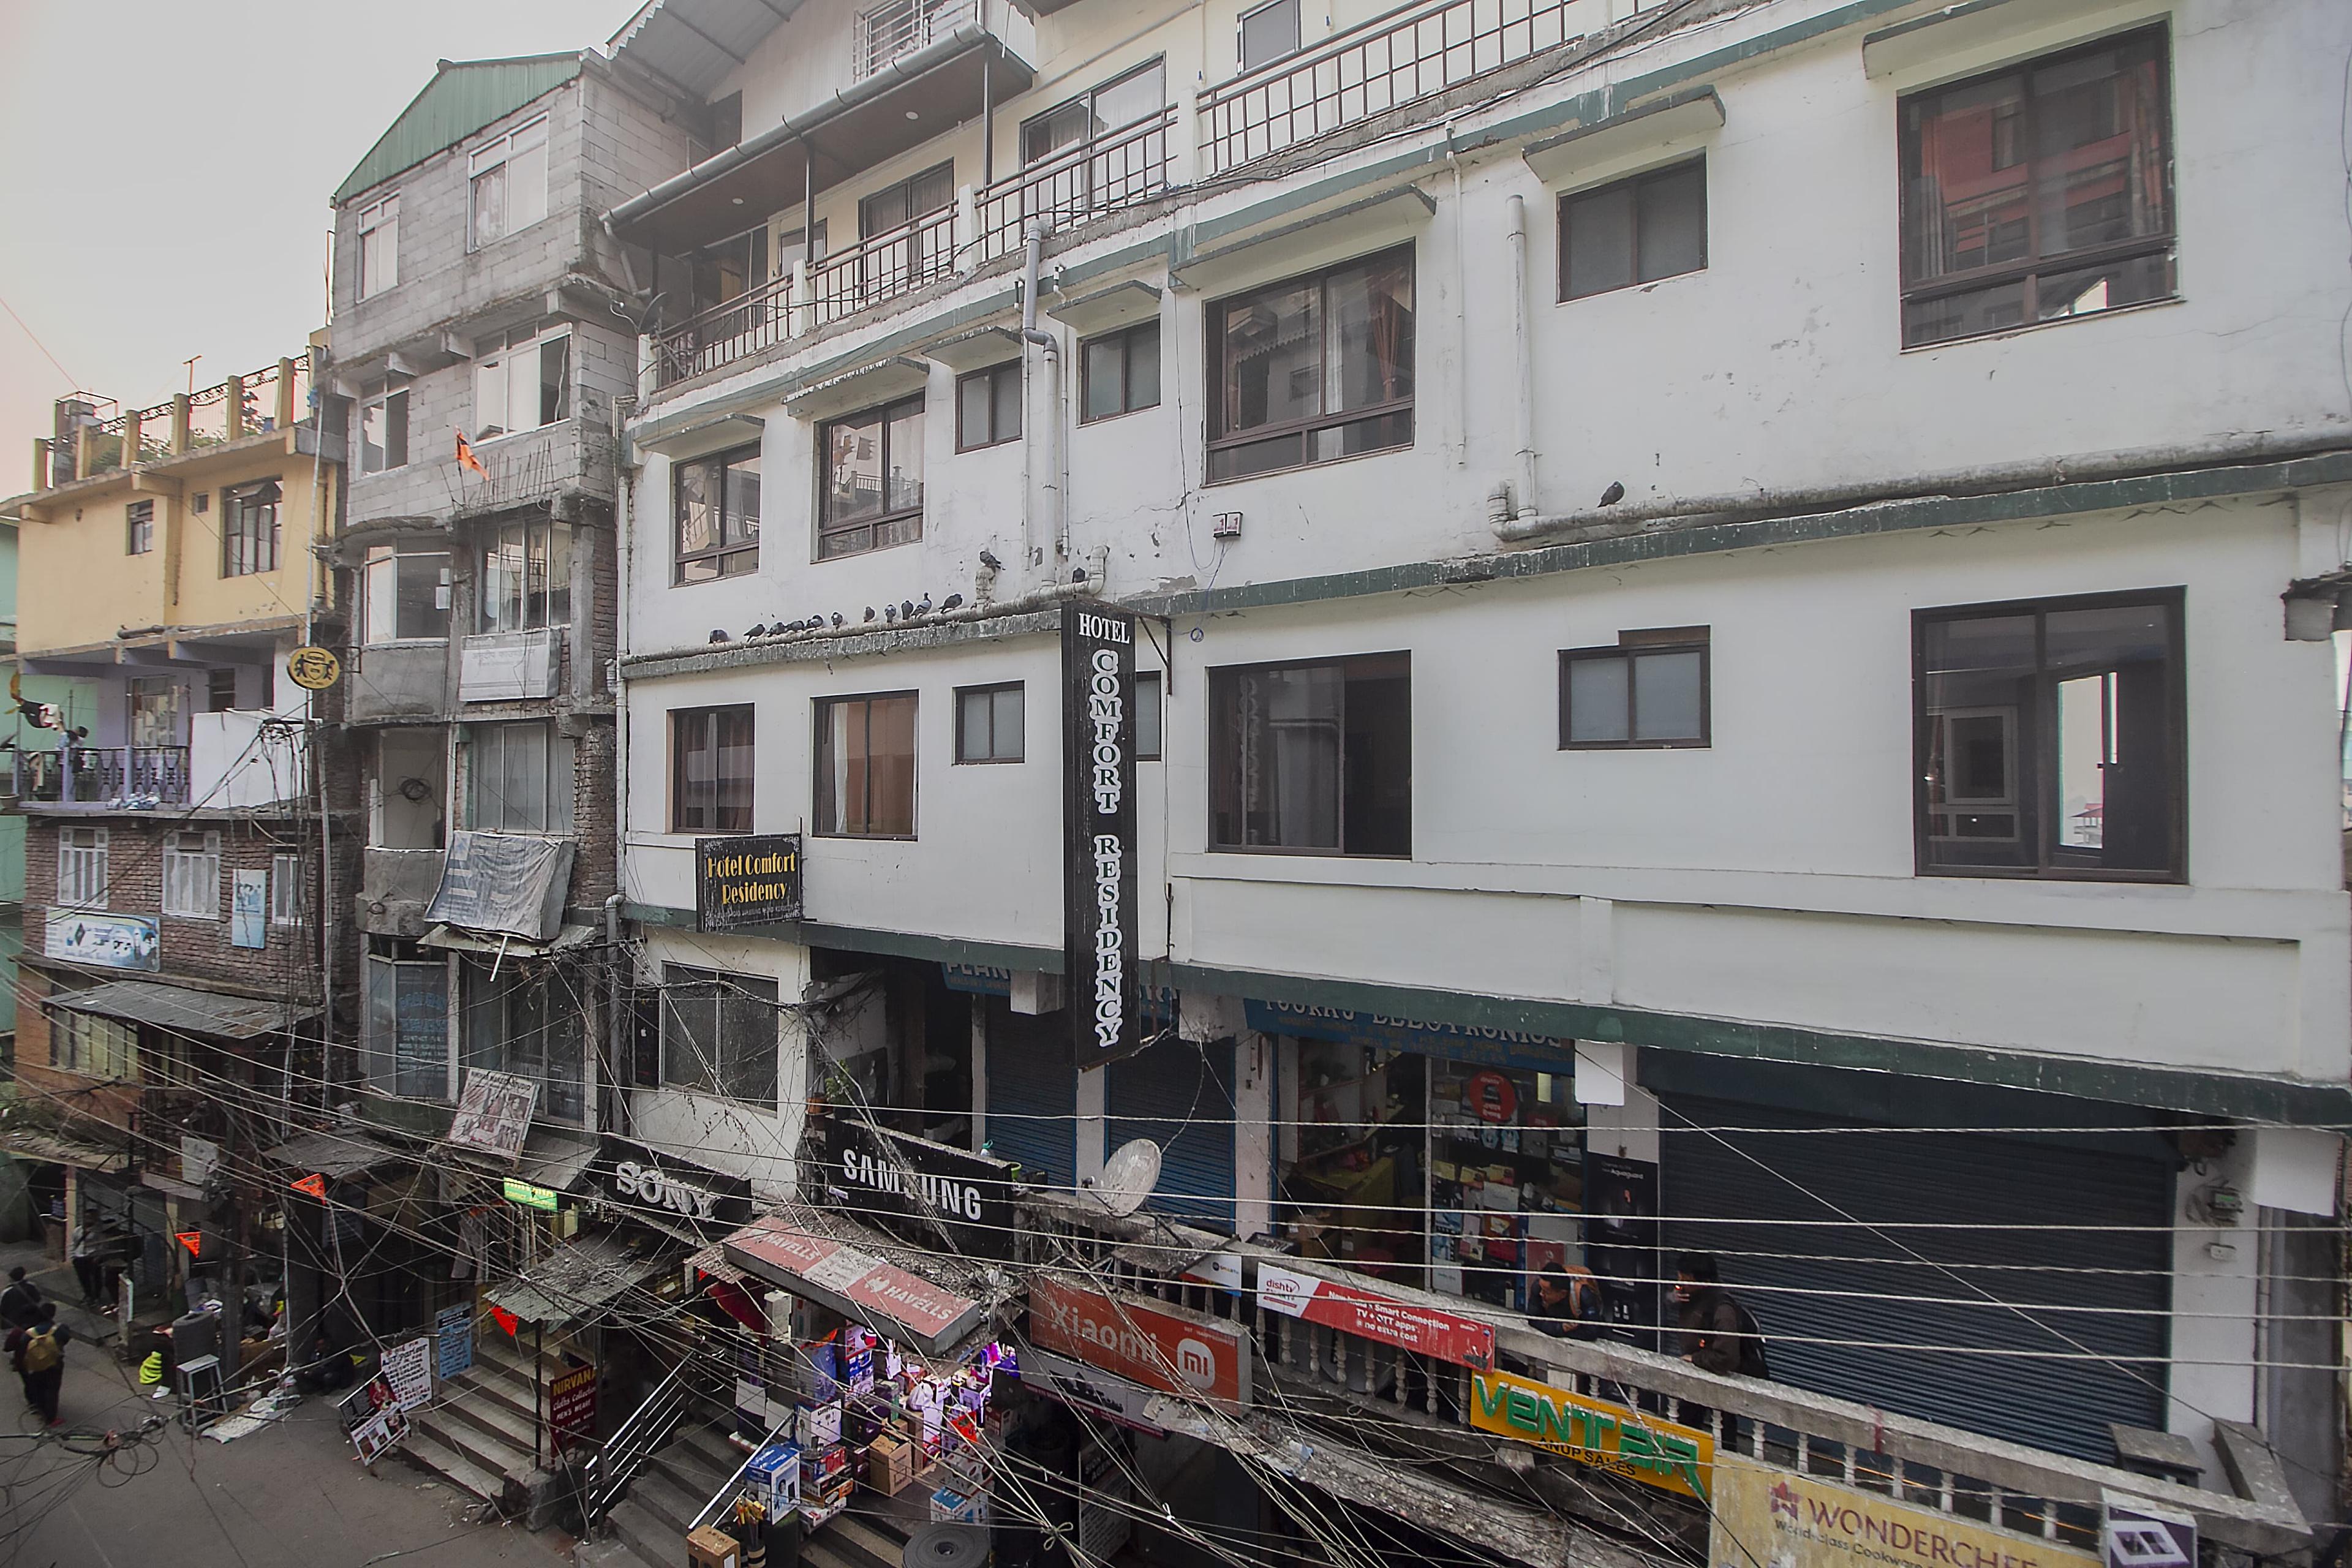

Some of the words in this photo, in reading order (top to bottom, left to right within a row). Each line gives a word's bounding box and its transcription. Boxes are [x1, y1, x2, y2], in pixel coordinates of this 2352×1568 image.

[1078, 612, 1130, 644] HOTEL
[1089, 649, 1123, 814] COMFORT
[707, 854, 742, 878] Hotel
[745, 851, 797, 876] Comfort
[722, 881, 788, 905] Residency
[1095, 834, 1123, 1047] RESIDENCY
[1610, 1167, 1644, 1180] Aquaguard
[616, 1161, 722, 1223] SONY
[765, 1231, 821, 1262] HAVELLS
[884, 1284, 954, 1320] HAVELLS
[1356, 1308, 1368, 1318] TV
[1374, 1303, 1400, 1317] Smart
[1400, 1311, 1450, 1332] Connection
[1050, 1302, 1158, 1364] Xiaomi
[1364, 1322, 1376, 1331] no
[1376, 1325, 1398, 1338] extra
[1399, 1331, 1419, 1343] cost
[552, 1368, 597, 1396] NIRVANA
[1538, 1436, 1581, 1458] ANUP
[1584, 1448, 1637, 1476] SALES
